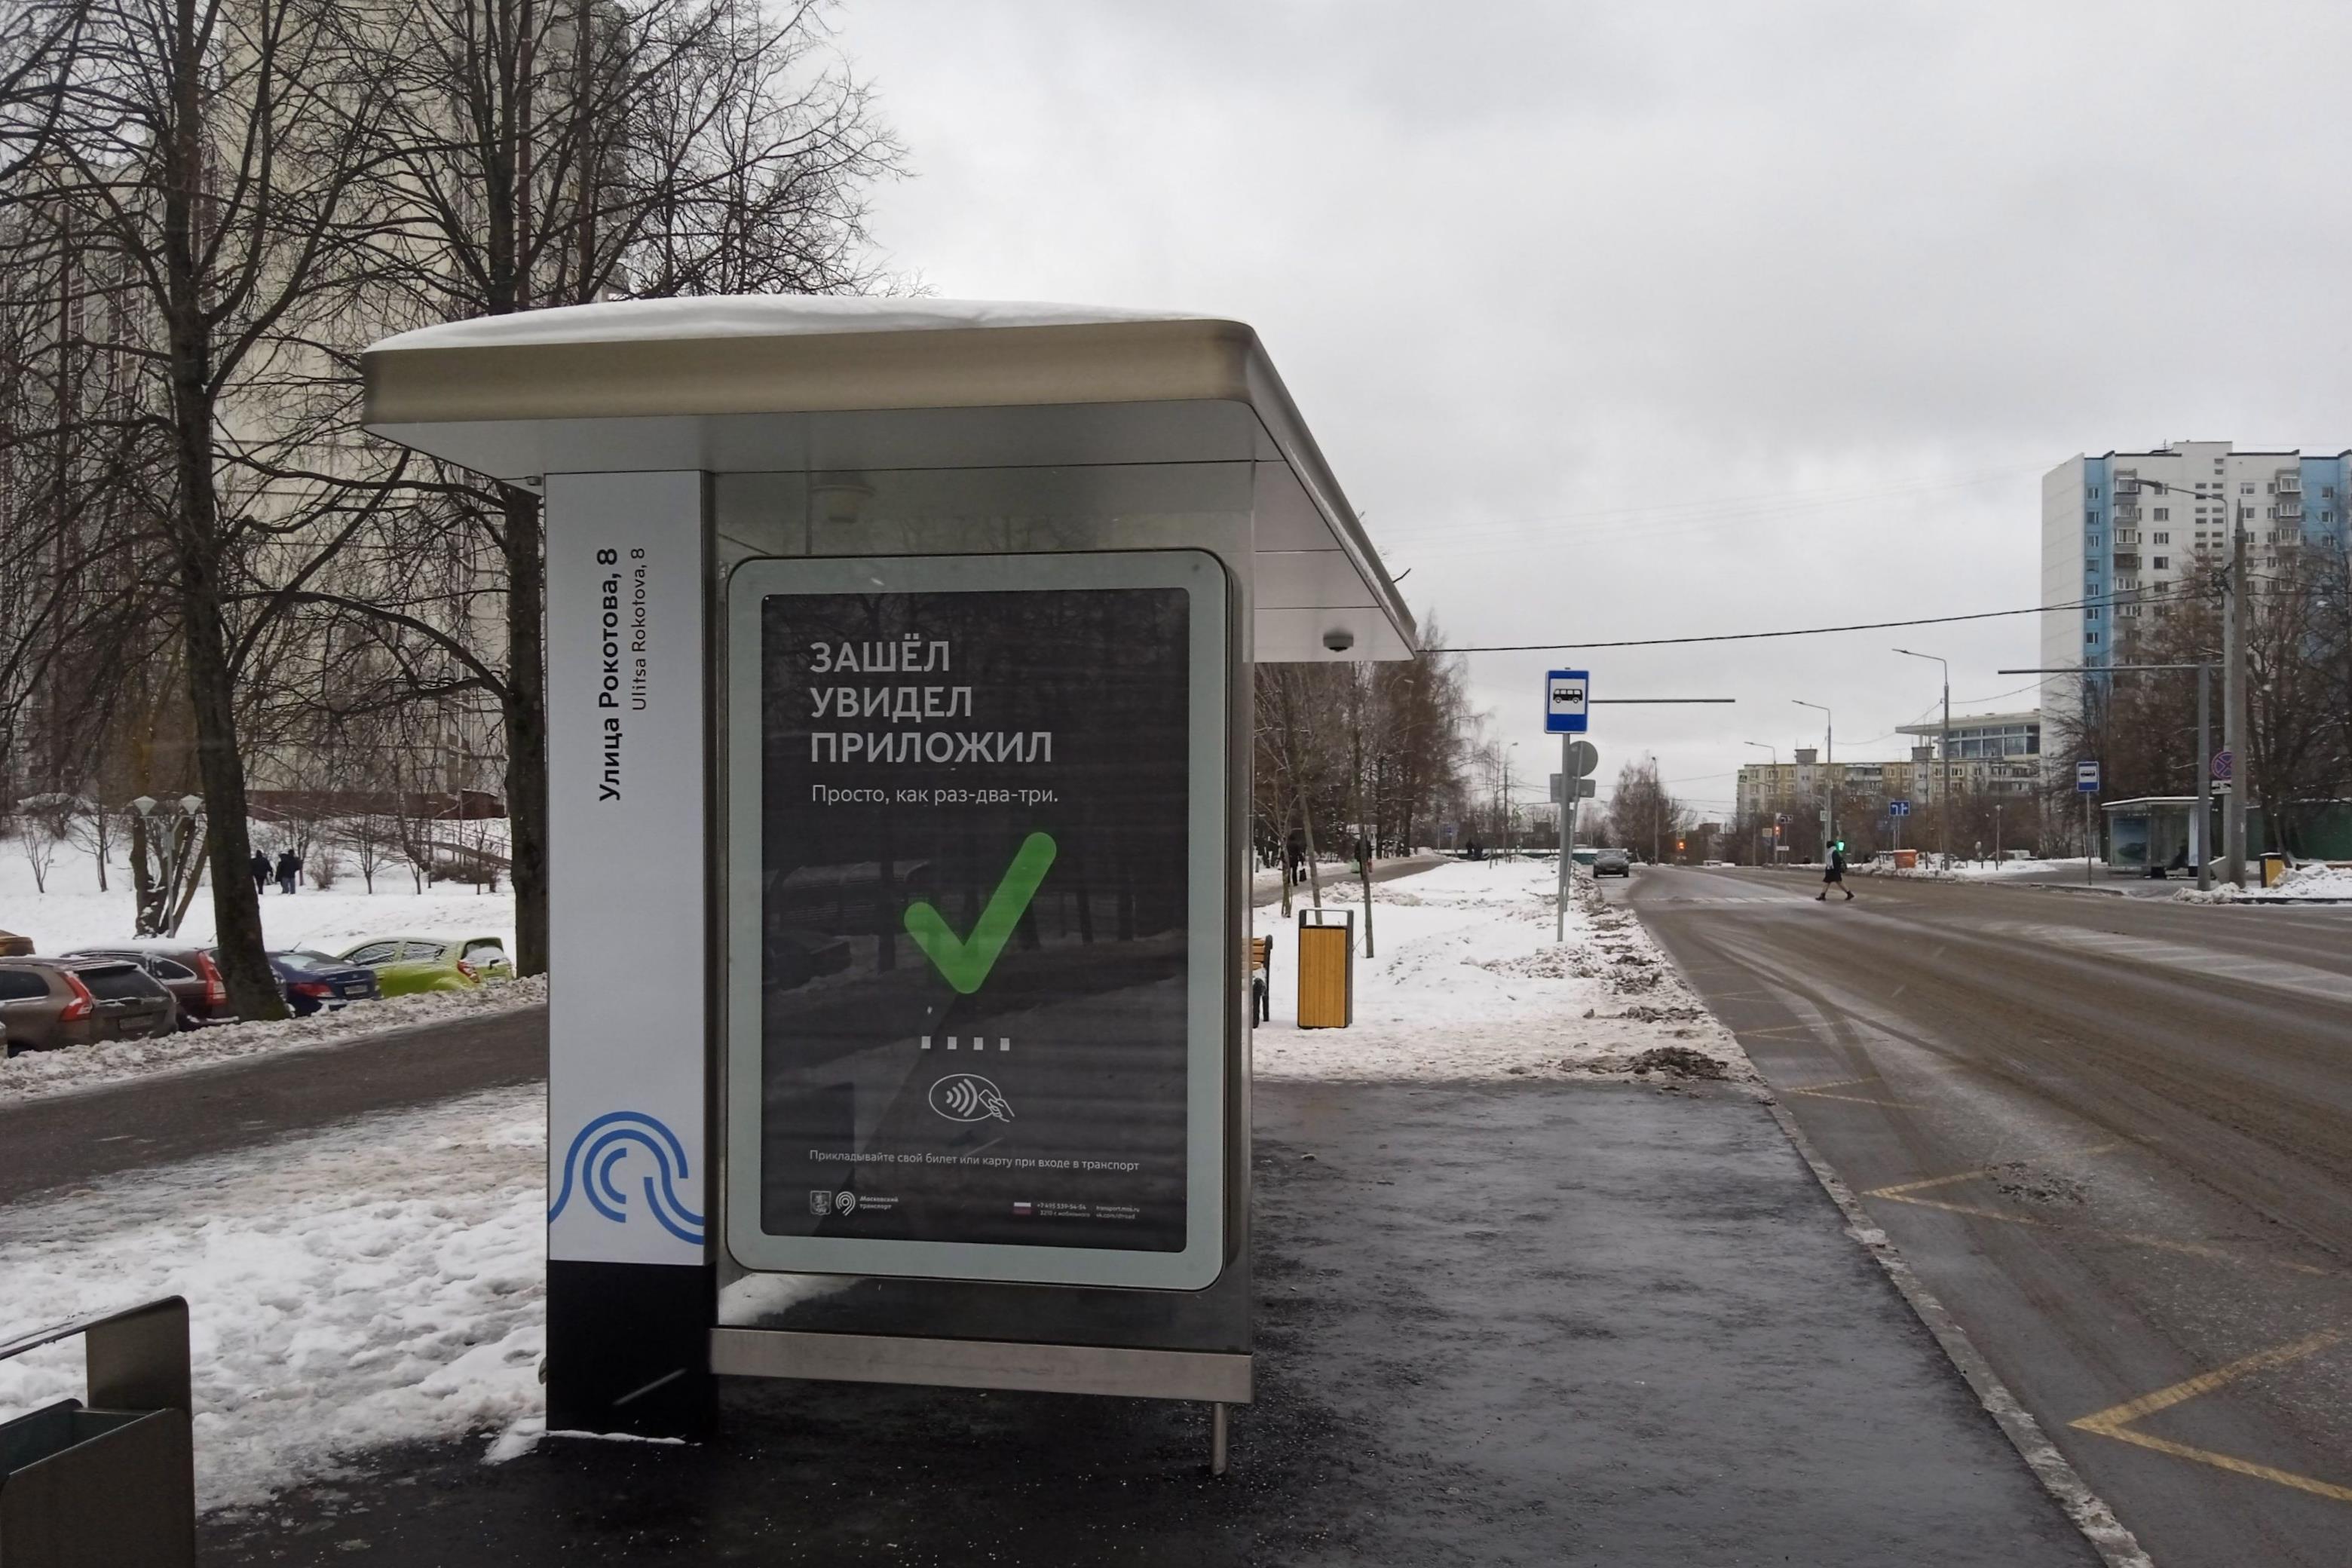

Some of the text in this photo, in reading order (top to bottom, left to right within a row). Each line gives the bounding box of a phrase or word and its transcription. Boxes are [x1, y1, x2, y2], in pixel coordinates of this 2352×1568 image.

[630, 547, 648, 710] Ulitsa Rokotova, 8
[810, 632, 950, 672] ЗАШЁЛ
[596, 548, 623, 801] Улица Рокотова, 8
[810, 686, 972, 723] УВИДЕЛ
[811, 731, 1052, 763] ПРИЛОЖИЛ
[812, 784, 1059, 806] Просто, как раз-два-три.
[809, 1150, 1140, 1171] Прикладывайте свой билет или карту при входе в транспорт
